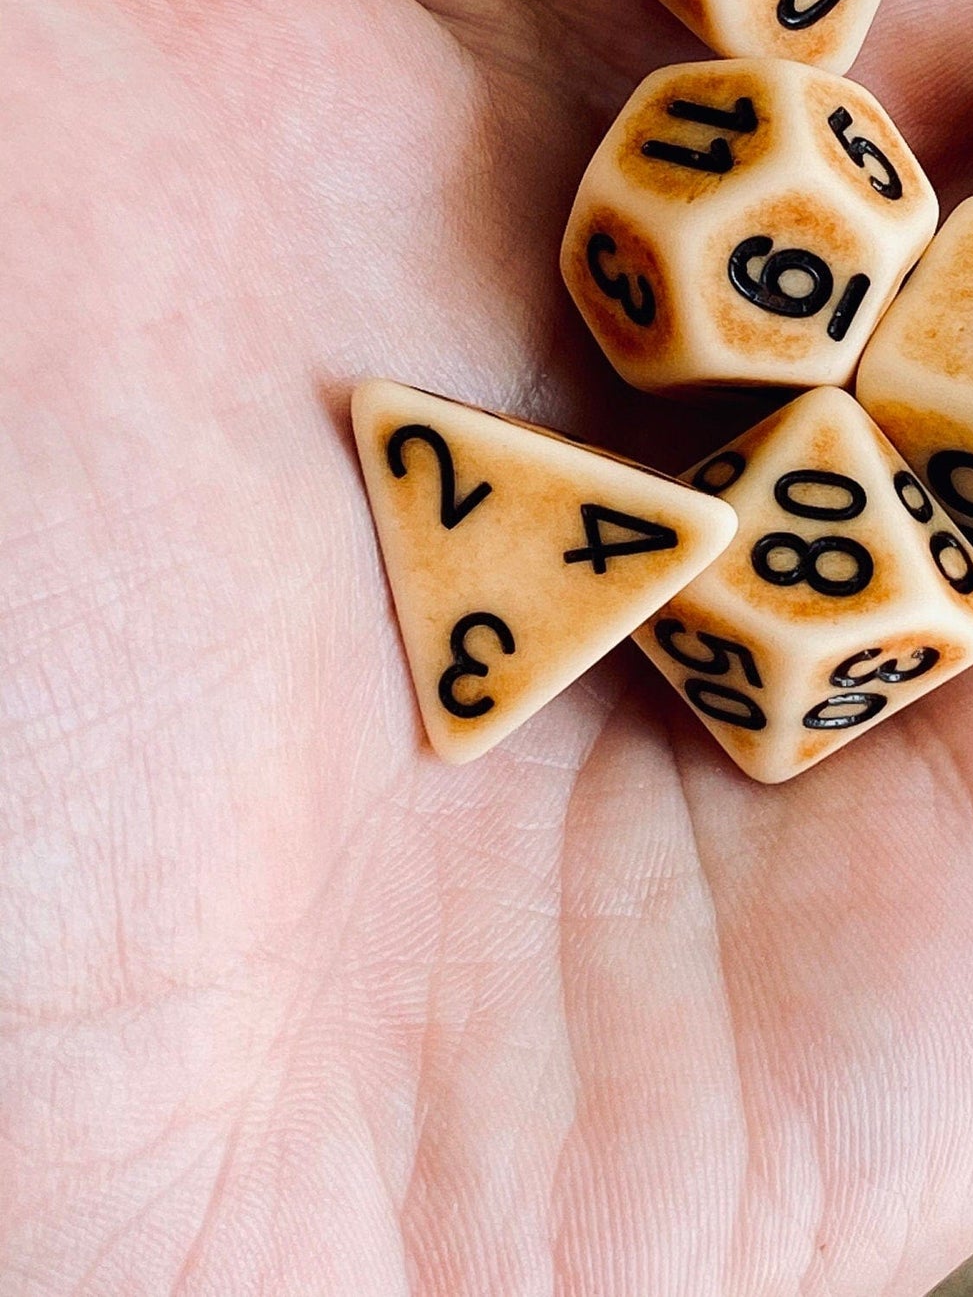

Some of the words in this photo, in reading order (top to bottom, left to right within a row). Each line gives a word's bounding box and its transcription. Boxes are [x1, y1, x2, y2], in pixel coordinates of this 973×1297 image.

[641, 97, 760, 173] 11
[827, 106, 904, 201] 5
[586, 232, 657, 328] 3
[386, 423, 494, 530] 2
[562, 503, 680, 575] 4
[750, 468, 875, 598] 80
[437, 611, 516, 720] 3
[653, 617, 768, 731] 50
